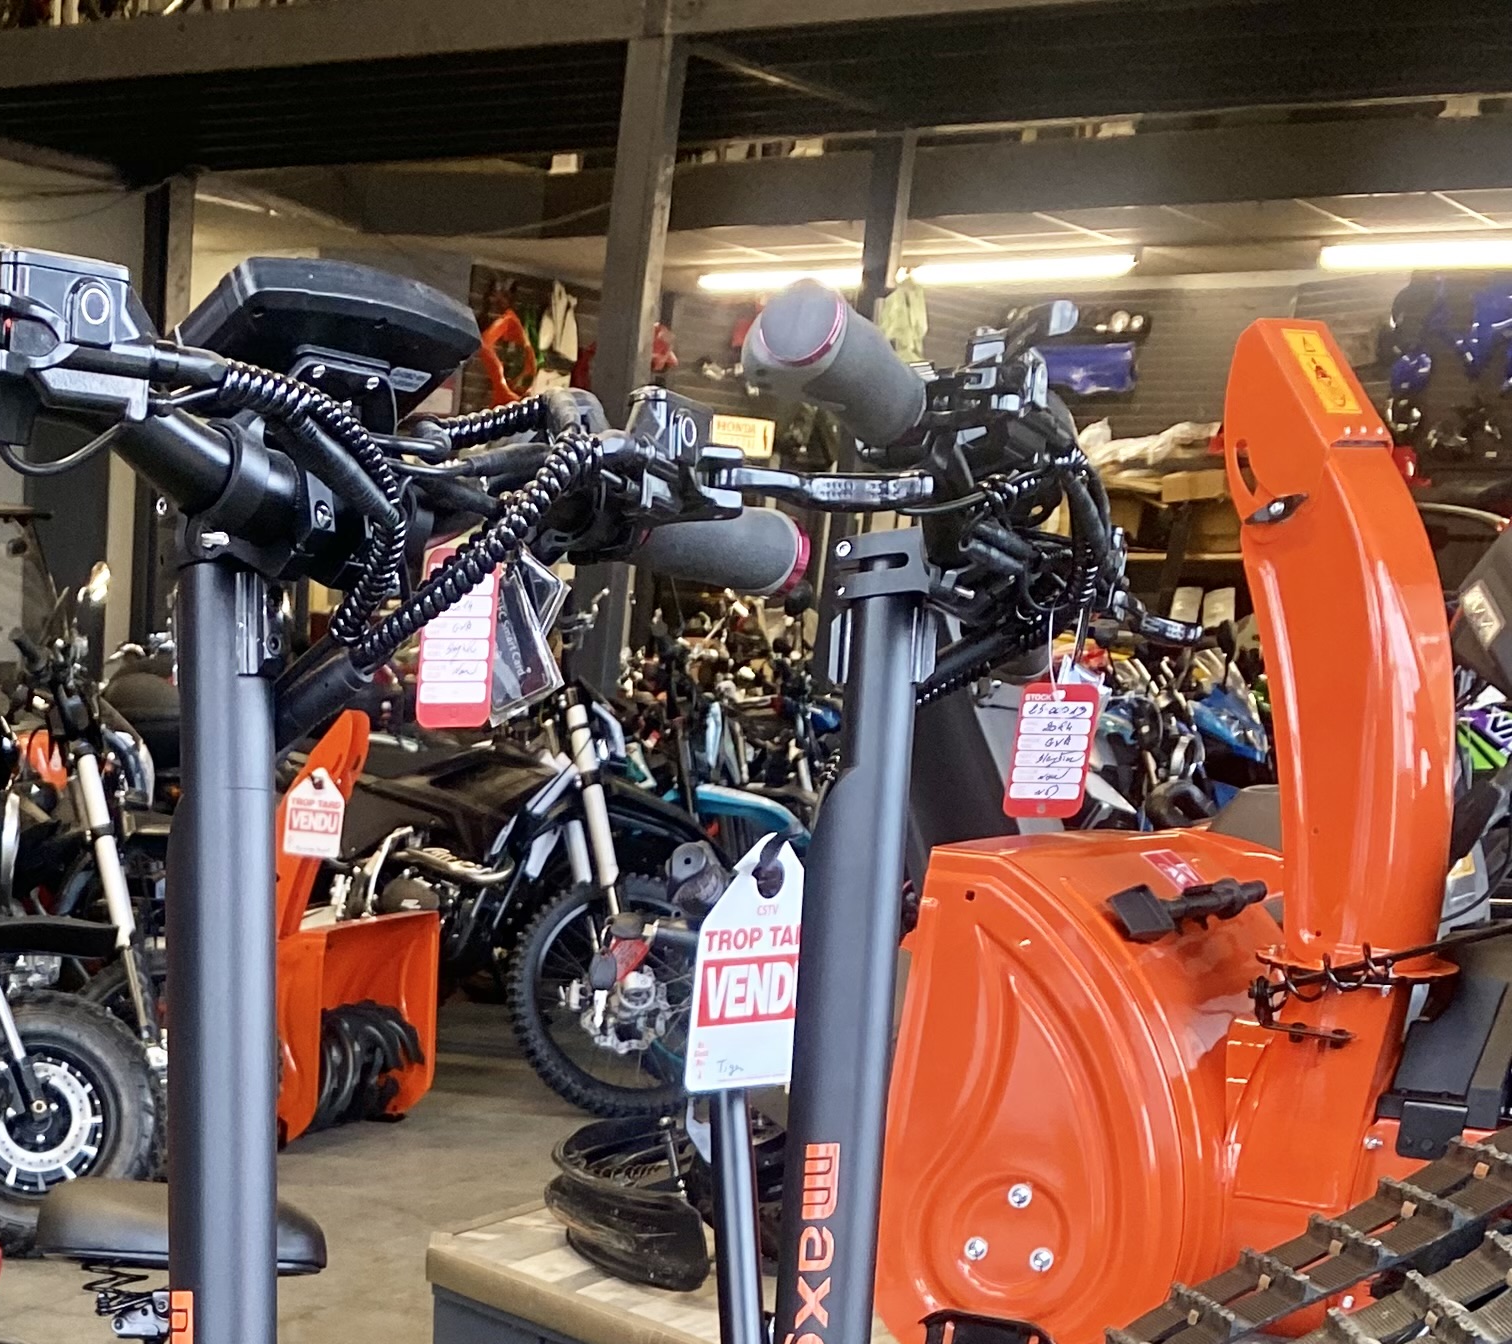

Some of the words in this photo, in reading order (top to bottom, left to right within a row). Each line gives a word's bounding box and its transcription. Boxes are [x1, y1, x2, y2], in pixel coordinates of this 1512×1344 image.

[501, 619, 519, 652] Smart
[512, 651, 527, 677] Card
[291, 809, 339, 834] VENDU
[705, 926, 764, 952] TROP
[769, 923, 802, 947] TA
